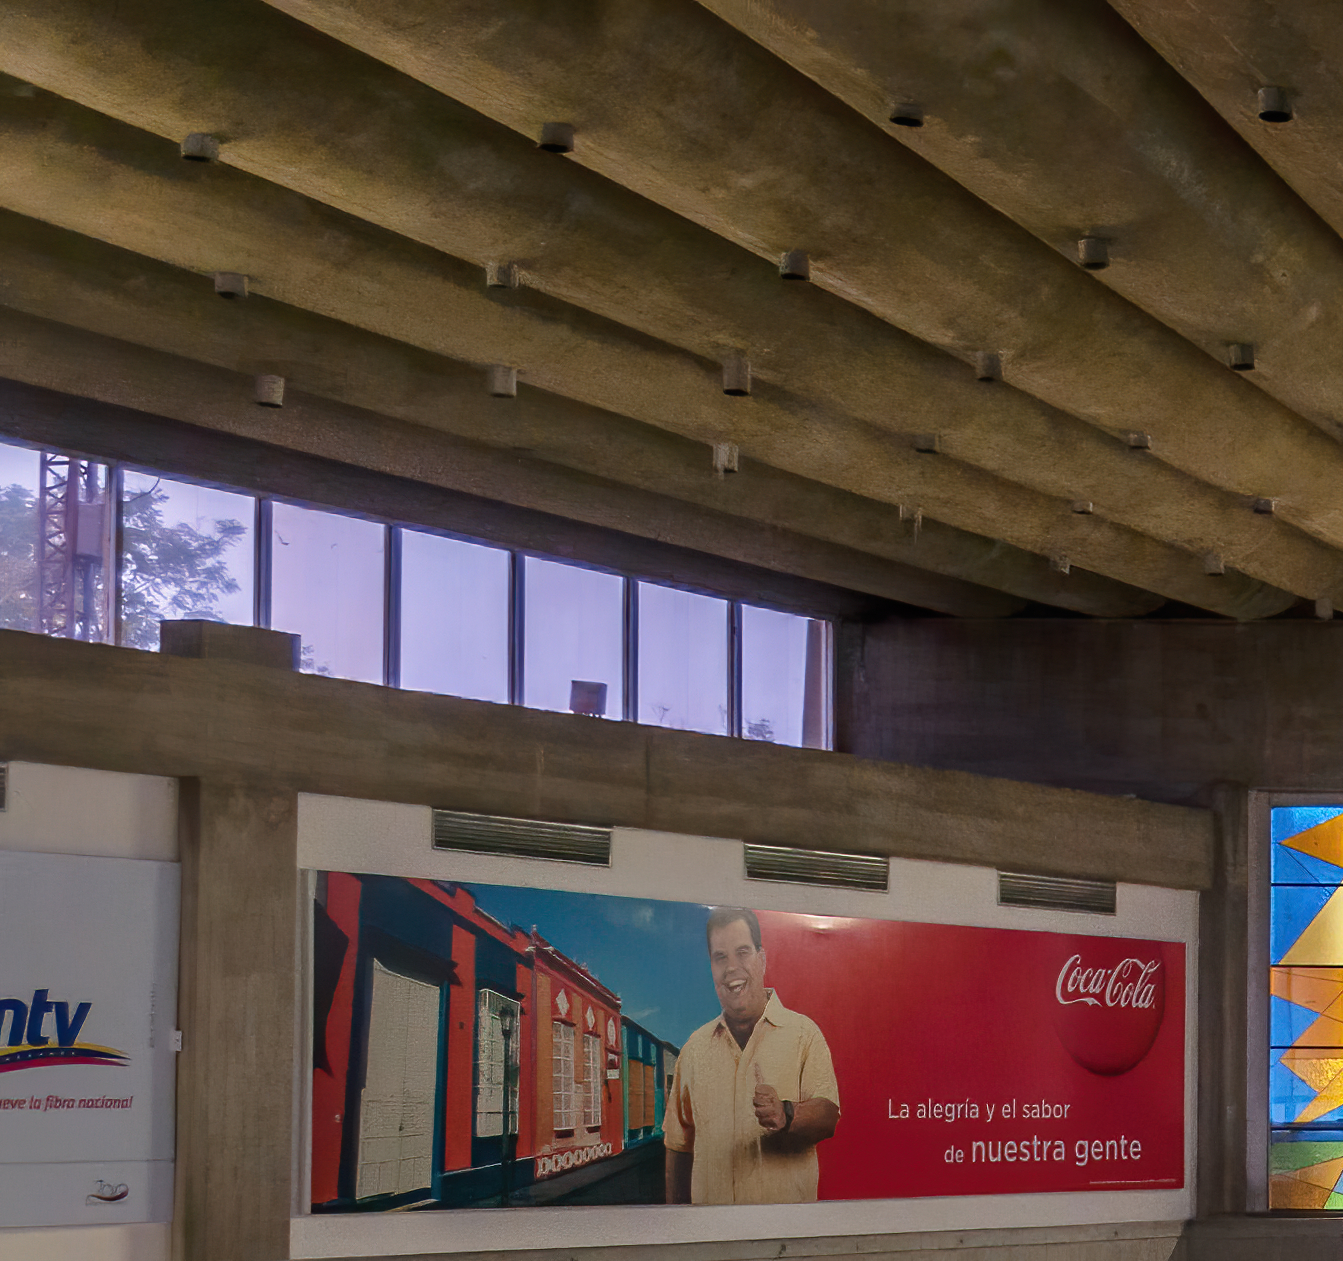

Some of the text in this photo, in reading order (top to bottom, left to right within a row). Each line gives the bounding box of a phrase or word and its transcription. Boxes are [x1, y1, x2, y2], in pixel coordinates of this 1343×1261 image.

[44, 1095, 75, 1112] fibra
[888, 1098, 1071, 1122] La alegría y el sabor
[944, 1135, 1142, 1166] de nuestra gente
